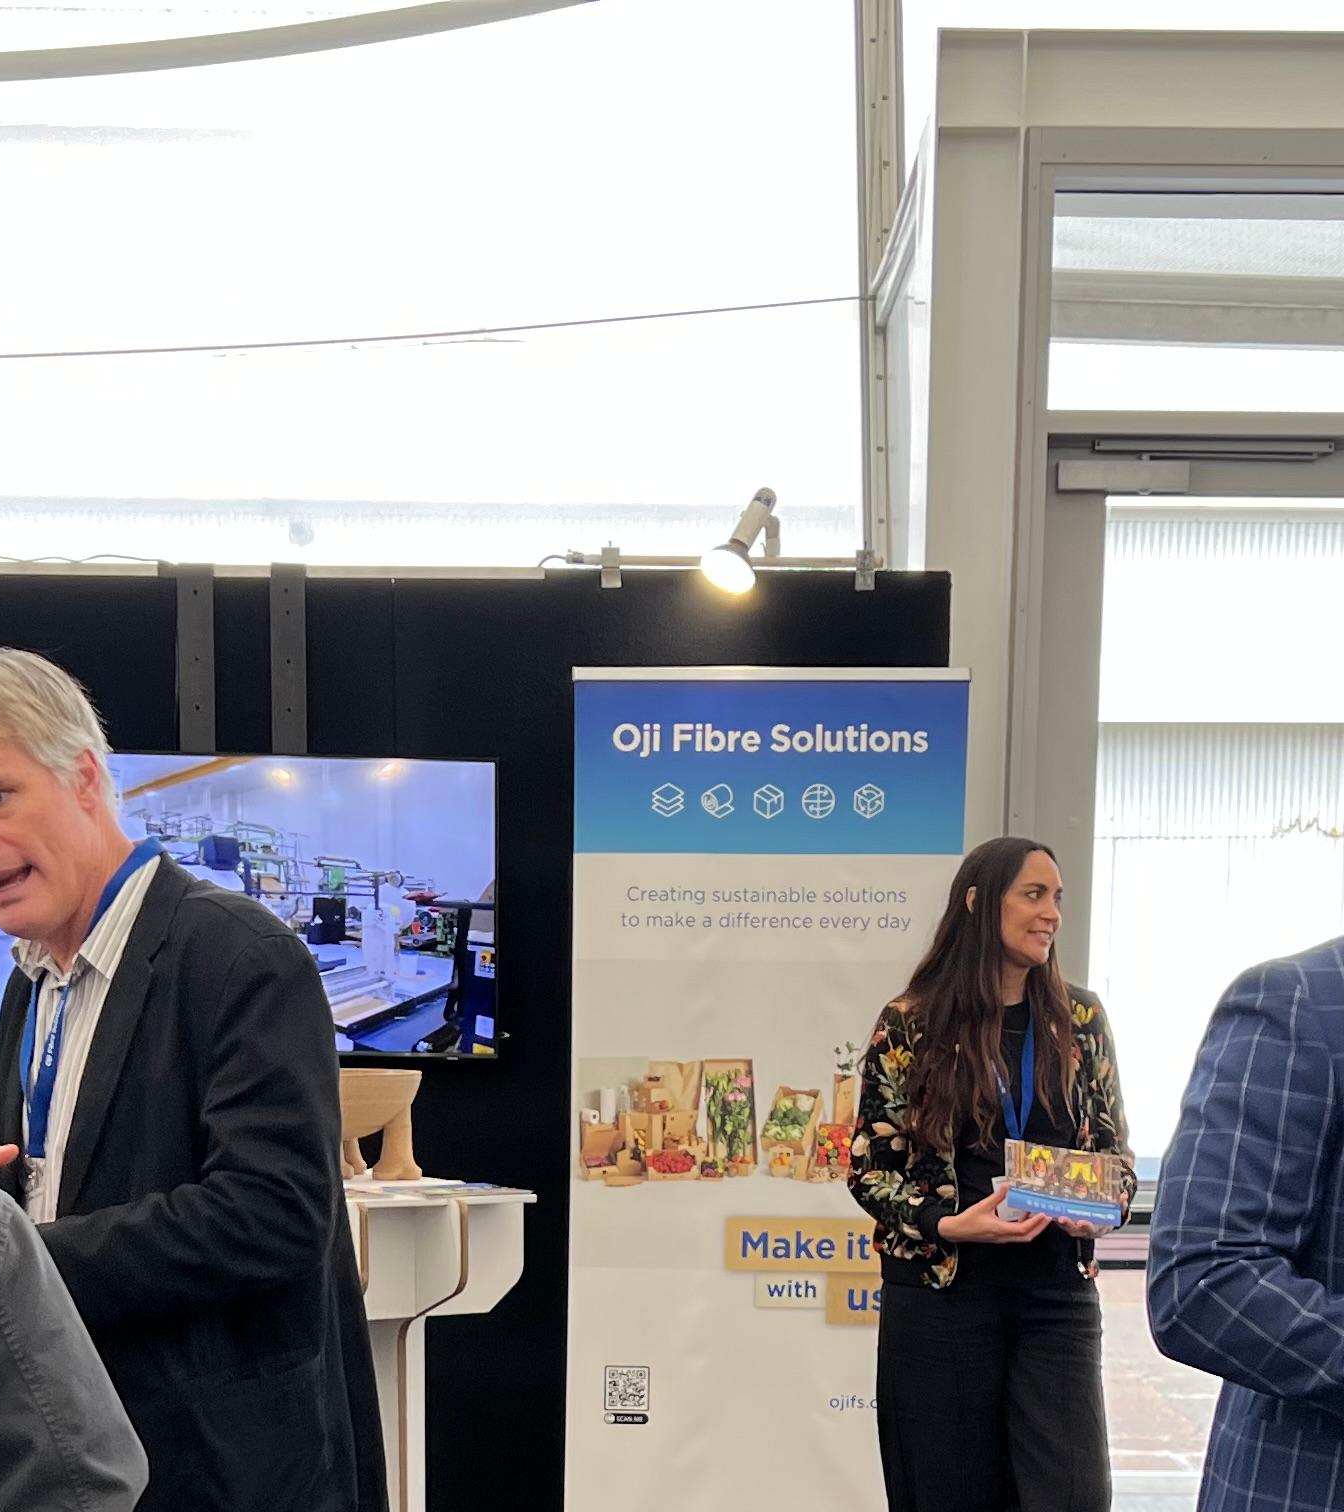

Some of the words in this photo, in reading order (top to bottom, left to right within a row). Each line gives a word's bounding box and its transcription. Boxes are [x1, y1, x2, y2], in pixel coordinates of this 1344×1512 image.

[612, 723, 661, 757] Oji
[673, 723, 761, 752] Fibre
[770, 723, 929, 752] Solutions
[626, 886, 706, 905] Creating
[712, 887, 817, 903] sustainable
[823, 887, 907, 903] solutions
[621, 912, 640, 928] to
[646, 912, 696, 928] make
[702, 916, 712, 928] a
[718, 912, 813, 929] difference
[819, 917, 870, 931] every
[877, 913, 912, 931] day
[742, 1231, 836, 1259] Make
[847, 1231, 871, 1260] it
[767, 1280, 816, 1298] with
[829, 1394, 877, 1411] ojifs.c
